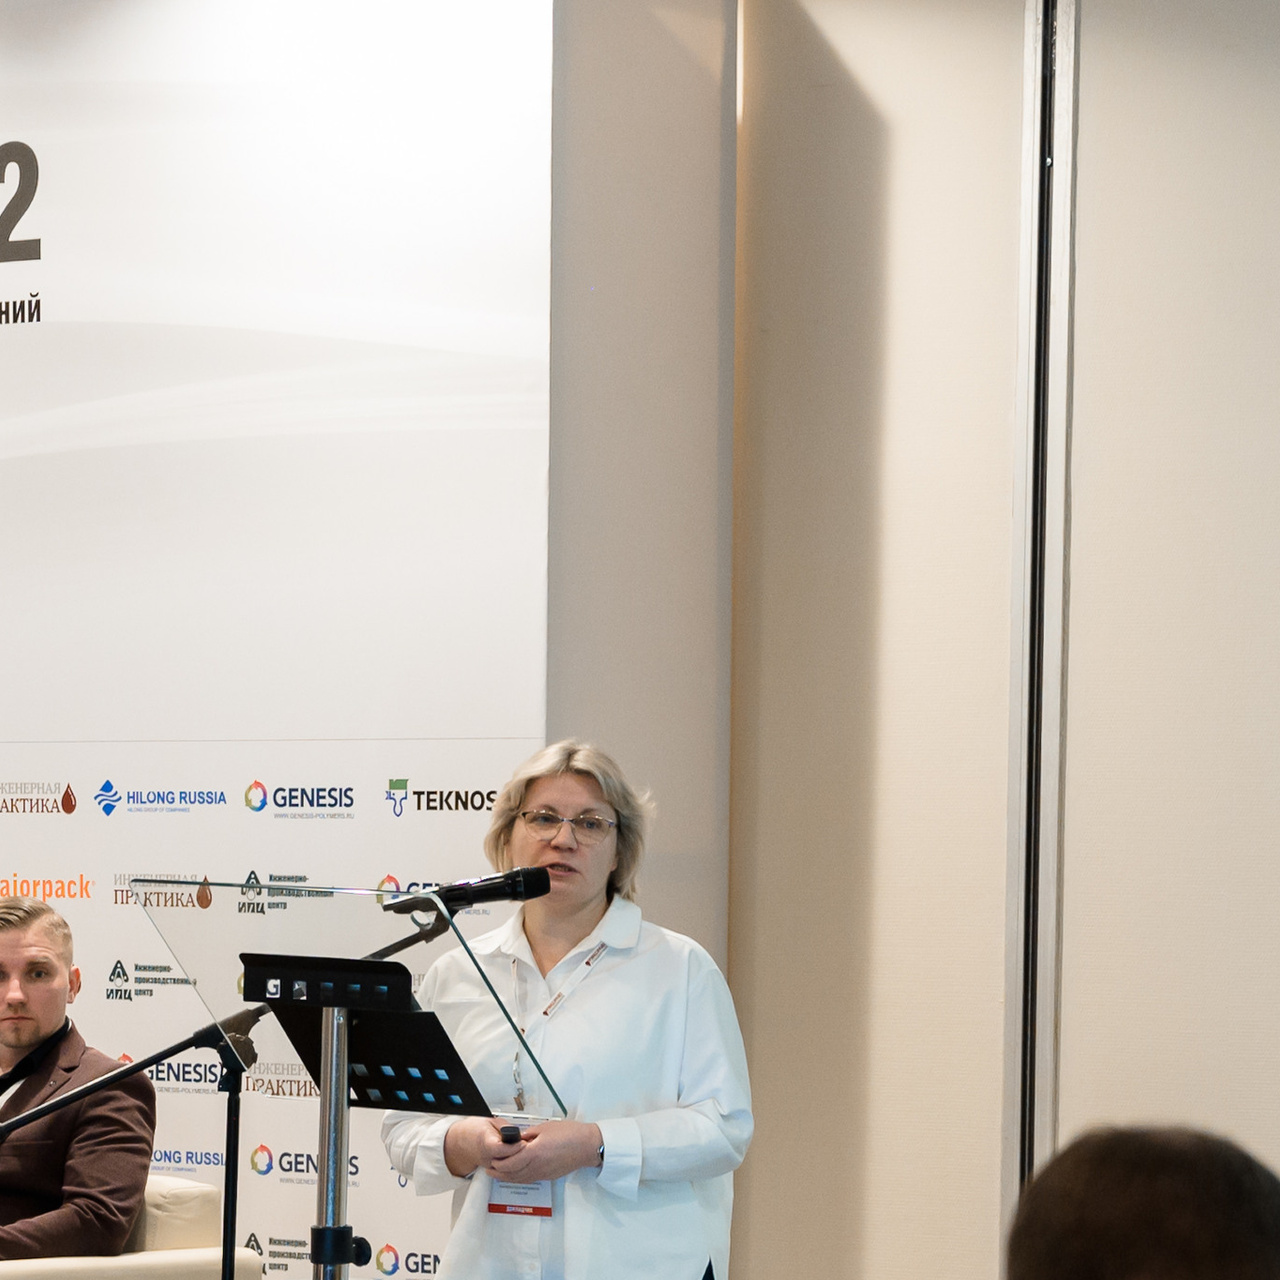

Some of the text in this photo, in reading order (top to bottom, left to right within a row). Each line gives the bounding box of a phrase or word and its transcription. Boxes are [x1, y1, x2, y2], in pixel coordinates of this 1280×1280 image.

[126, 790, 227, 805] HILONG RUSSIA
[272, 786, 354, 808] GENESIS
[412, 790, 498, 812] TEKNOS
[114, 888, 196, 908] ПРАКТИКА
[238, 902, 266, 915] ИПЦ
[268, 901, 288, 910] центр
[106, 988, 132, 1002] ИПЦ
[134, 988, 153, 997] центр
[252, 1062, 308, 1076] НЖЕНЕР
[246, 1076, 321, 1096] ПРАКТИК
[185, 1152, 227, 1166] RUSSI
[279, 1152, 359, 1176] GENS
[269, 1250, 312, 1261] производст
